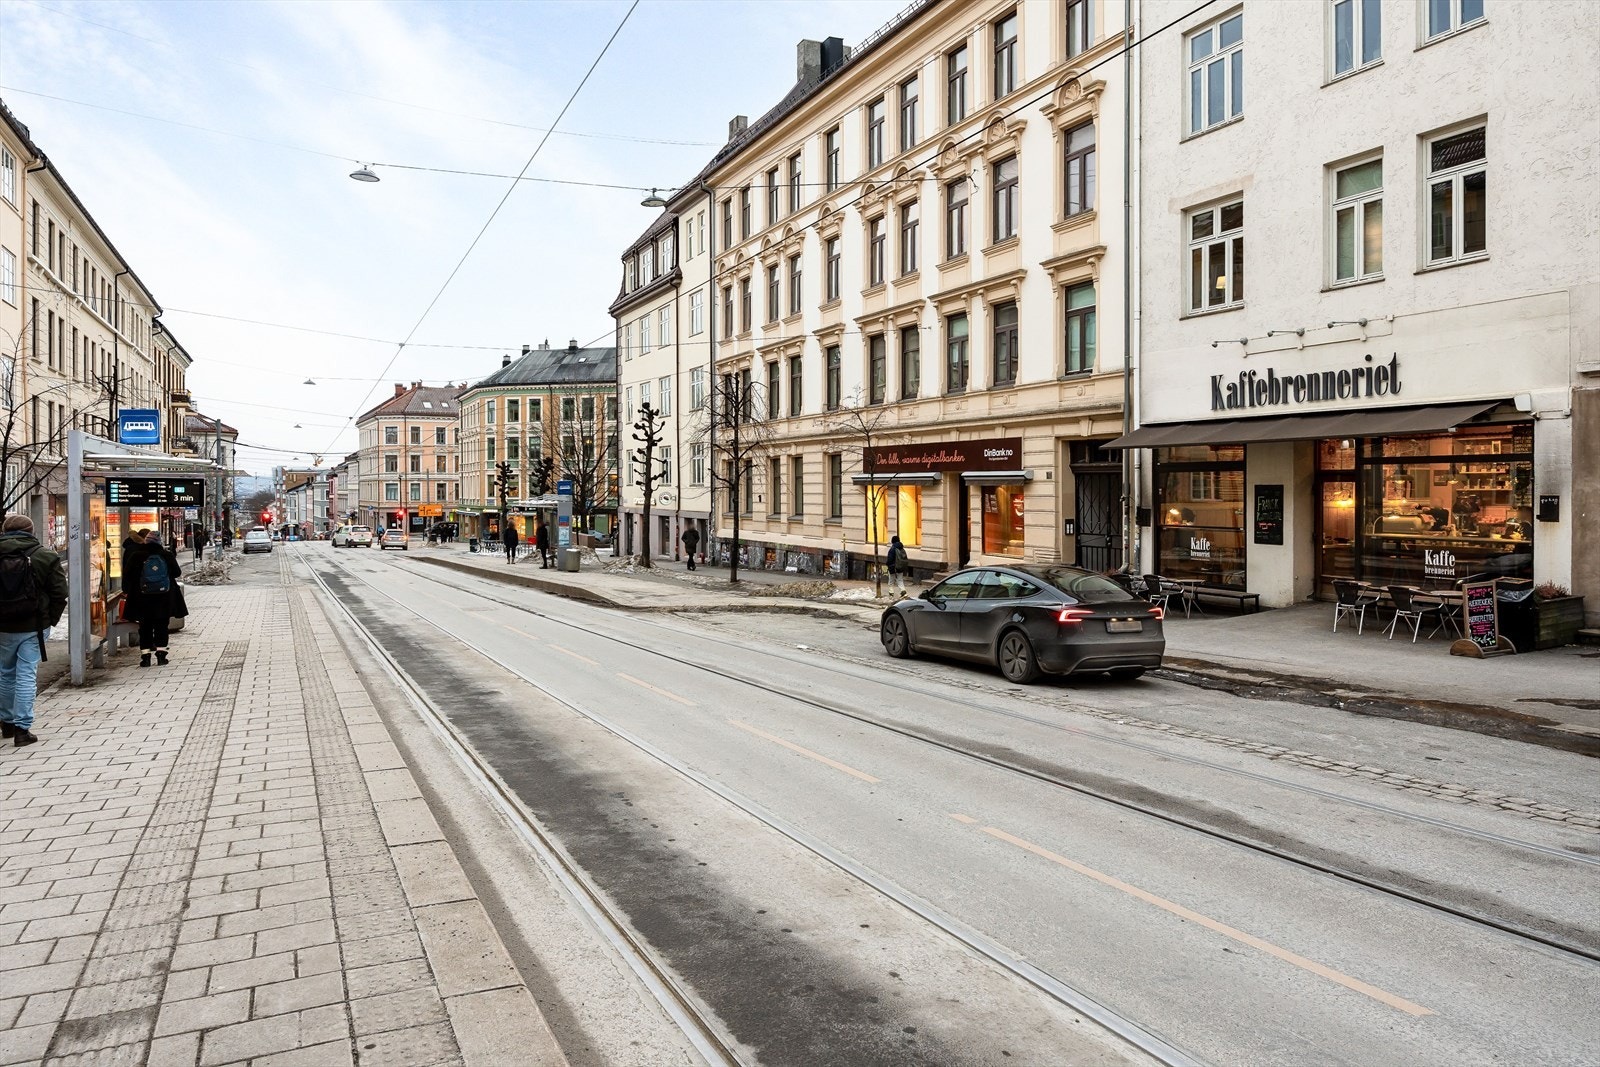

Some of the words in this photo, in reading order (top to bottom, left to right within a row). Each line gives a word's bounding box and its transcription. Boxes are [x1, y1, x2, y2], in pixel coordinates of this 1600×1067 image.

[1210, 352, 1402, 411] Kaffebrenneriet
[876, 453, 888, 465] Den
[901, 456, 921, 464] varme
[921, 449, 966, 469] digitalbanken
[173, 494, 179, 502] 3
[180, 494, 194, 502] min
[1190, 536, 1211, 551] Kaffe
[1424, 549, 1456, 567] Kaffe
[1424, 565, 1455, 576] brenneriet
